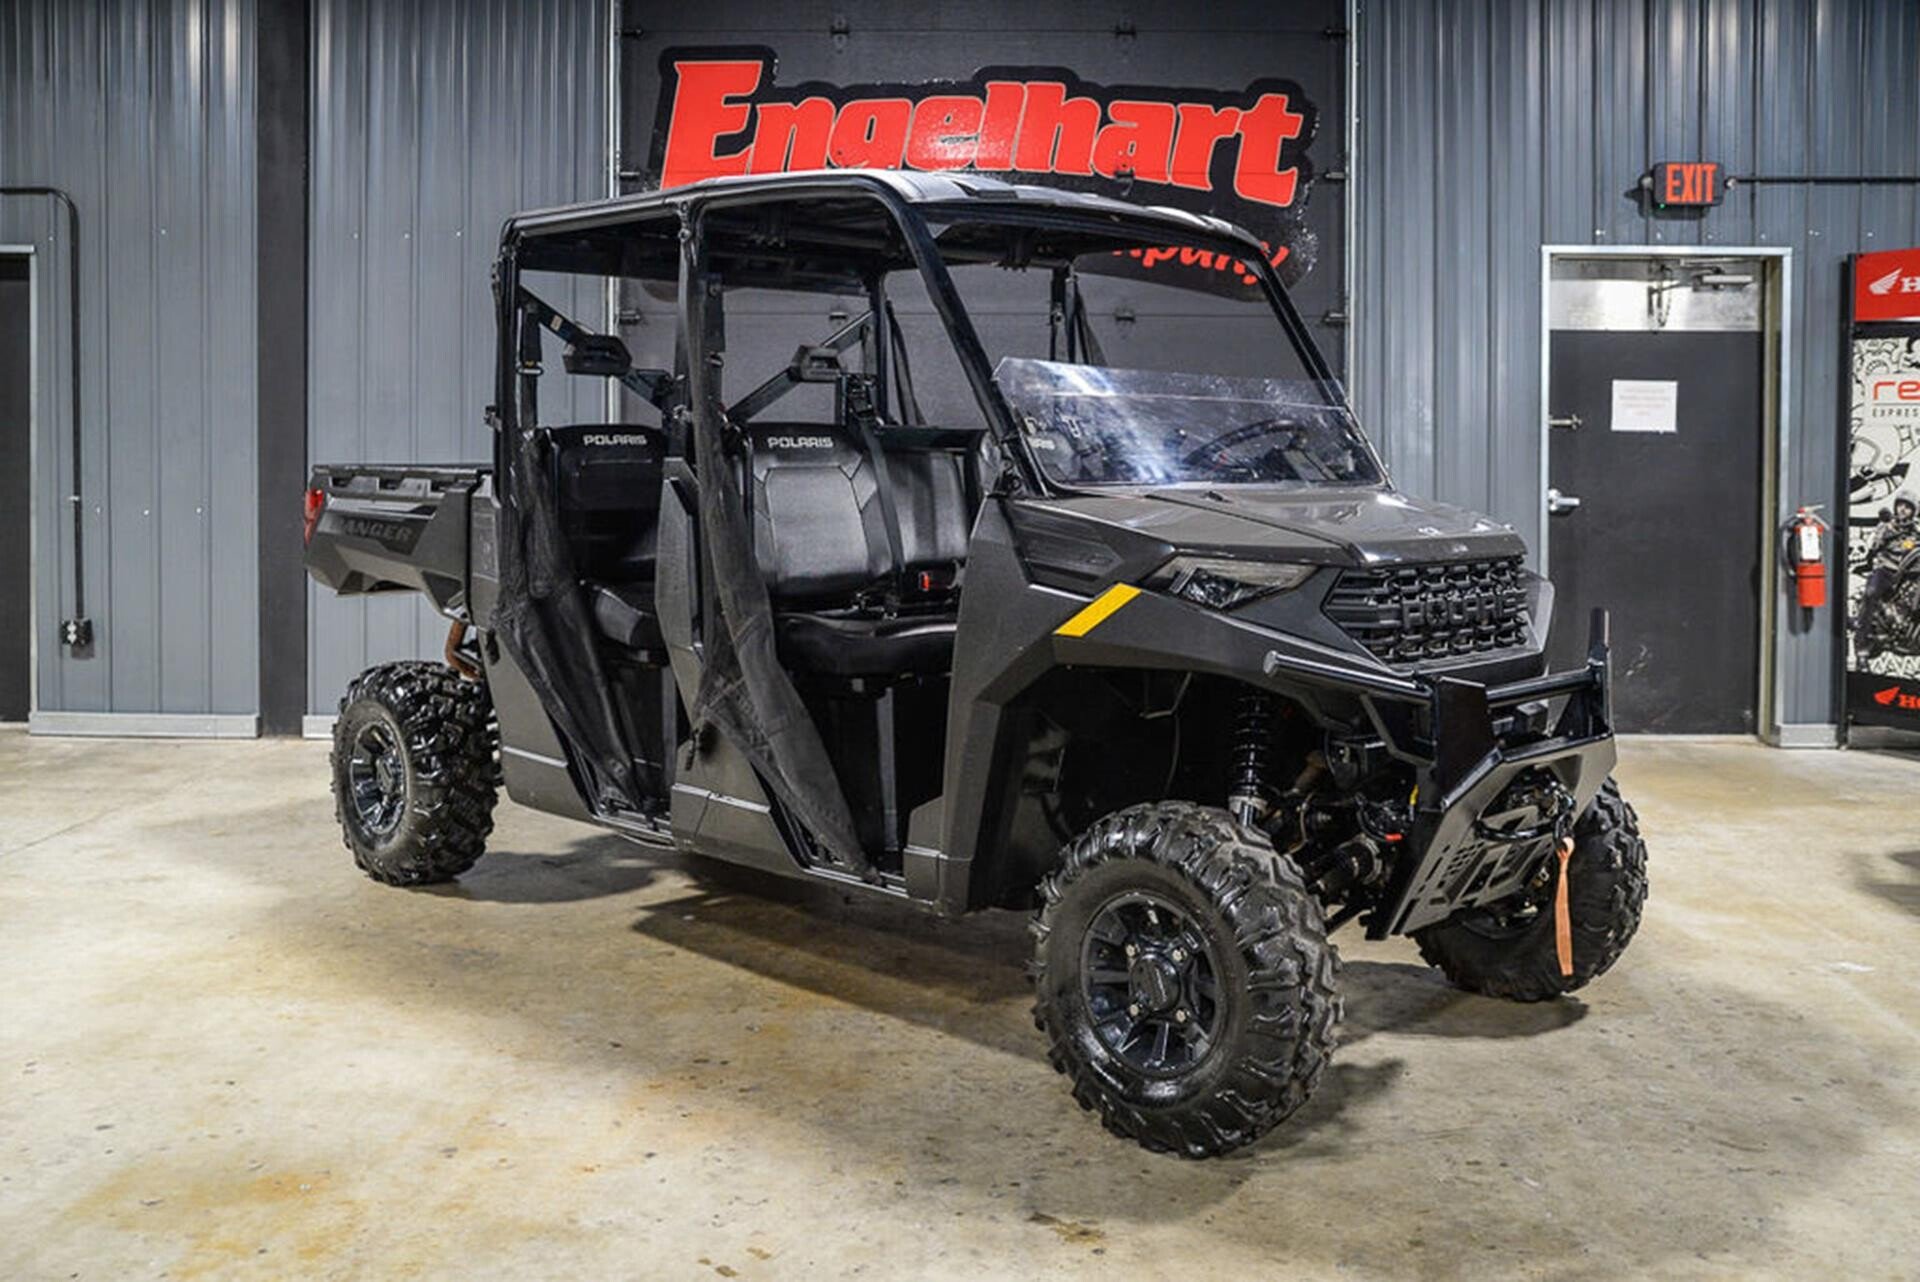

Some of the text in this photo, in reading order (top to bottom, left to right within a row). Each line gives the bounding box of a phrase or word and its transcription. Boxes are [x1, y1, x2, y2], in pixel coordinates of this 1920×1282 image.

[662, 60, 1303, 207] Engelhart
[1666, 163, 1717, 204] EXIT
[583, 434, 648, 446] POLARIS
[767, 436, 834, 449] POLARIS
